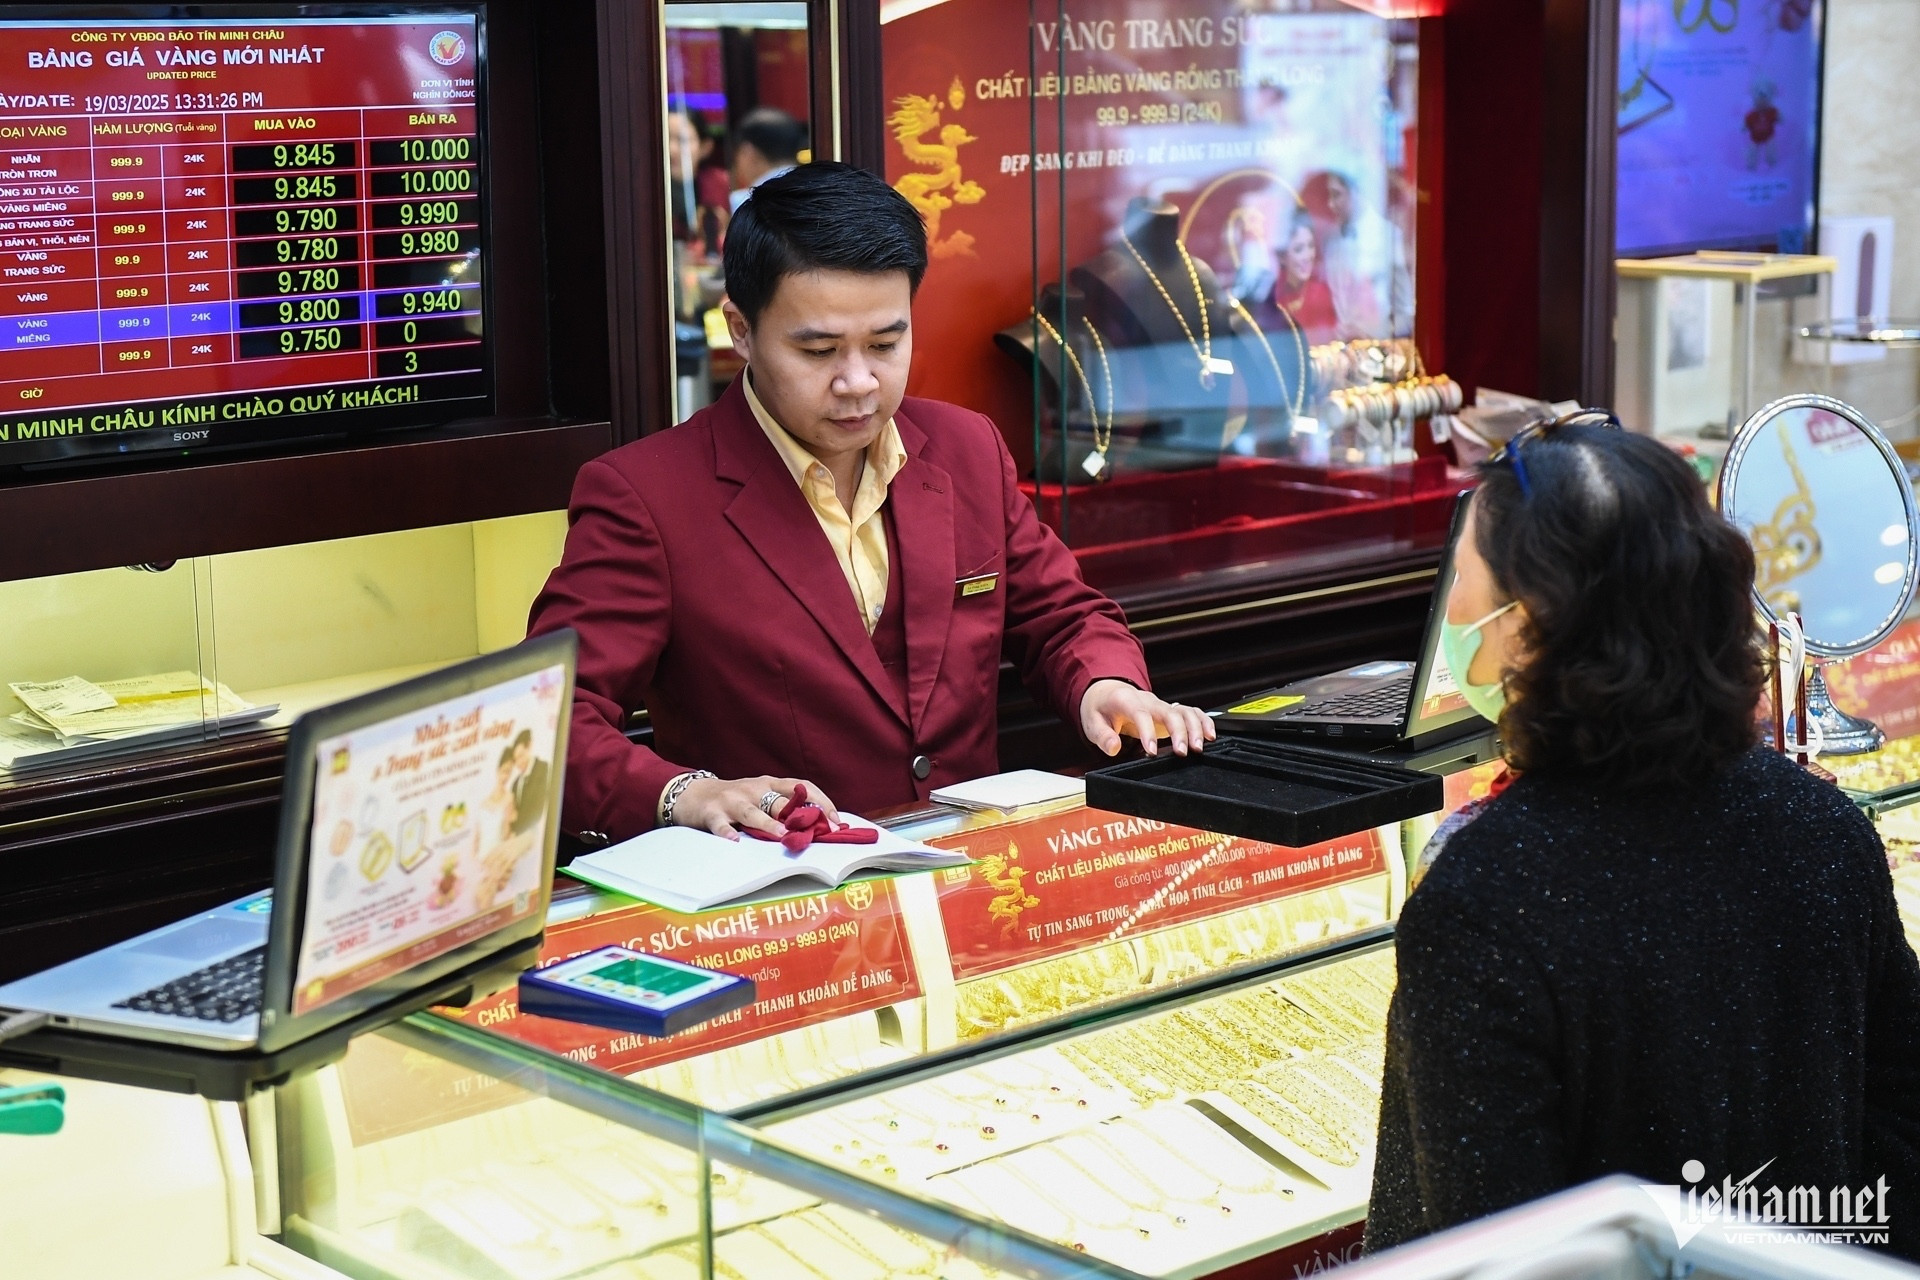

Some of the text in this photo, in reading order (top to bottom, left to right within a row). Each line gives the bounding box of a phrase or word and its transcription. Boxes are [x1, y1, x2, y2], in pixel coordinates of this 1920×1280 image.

[71, 31, 108, 42] CÔNG
[111, 32, 127, 42] TY
[130, 32, 165, 42] VBĐQ
[197, 30, 216, 41] TÍN
[220, 31, 249, 41] MINH
[252, 29, 285, 40] CHÂU
[1123, 17, 1214, 49] TRANG
[28, 44, 325, 68] BẢNG GIÁ VÀNG MỚI NHẤT
[147, 70, 217, 80] UPDATED PRICE
[454, 78, 474, 87] TÍNH
[976, 69, 1024, 100] CHẤT
[1073, 65, 1122, 95] BẰNG
[1125, 67, 1172, 93] VÀNG
[85, 94, 169, 114] 19/03/2025
[175, 92, 238, 109] 13:31:26
[242, 92, 263, 107] PM
[409, 113, 457, 125] BÁN RA
[1096, 105, 1129, 127] 99.9
[1139, 103, 1181, 125] 999.9
[93, 122, 122, 134] HÀM
[125, 122, 173, 135] LƯỢNG
[254, 117, 316, 130] MUA VÀO
[0, 124, 67, 139] OẠI VÀNG
[273, 143, 335, 167] 9.845
[400, 138, 469, 162] 10.000
[110, 157, 143, 167] 999.9
[184, 155, 205, 163] 24K
[1000, 153, 1030, 177] ĐẸP
[1077, 150, 1104, 169] KHI
[27, 169, 57, 178] TRƠN
[400, 169, 471, 193] 10.000
[23, 188, 37, 196] XU
[39, 185, 56, 195] TÀI
[58, 184, 80, 195] LỘC
[185, 188, 206, 196] 24K
[275, 176, 336, 199] 9.845
[112, 191, 145, 200] 999.9
[276, 208, 337, 232] 9.790
[400, 202, 459, 226] 9.990
[17, 218, 75, 229] TRANG SỨC
[113, 224, 146, 234] 999.9
[186, 220, 207, 229] 24K
[277, 237, 338, 262] 9.780
[401, 230, 459, 255] 9.980
[17, 251, 47, 261] VÀNG
[114, 255, 141, 265] 99.9
[187, 251, 208, 259] 24K
[4, 264, 66, 276] TRANG SỨC
[189, 283, 209, 292] 24K
[278, 268, 339, 293] 9.780
[17, 292, 48, 302] VÀNG
[116, 288, 148, 298] 999.9
[403, 290, 461, 314] 9.940
[191, 313, 211, 322] 24K
[279, 298, 340, 323] 9.800
[17, 319, 48, 329] VÀNG
[118, 317, 150, 328] 999.9
[403, 321, 417, 343] 0
[280, 327, 341, 353] 9.750
[119, 350, 151, 361] 999.9
[191, 345, 212, 354] 24K
[405, 351, 418, 373] 3
[20, 387, 43, 399] GIỜ
[17, 385, 419, 440] MINH CHÂU KÍNH CHÀO QUÝ KHÁCH!
[173, 430, 210, 442] SONY
[1047, 827, 1102, 854] VÀNG
[1035, 861, 1066, 885] CHẤT
[1067, 858, 1093, 878] LIỆU
[1094, 850, 1126, 871] BẰNG
[1126, 844, 1157, 863] VÀNG
[1114, 873, 1130, 889] Giá
[1027, 924, 1041, 942] TỰ
[1045, 921, 1063, 938] TIN
[1066, 913, 1093, 932] SANG
[1095, 905, 1130, 925] TRỌNG
[1192, 881, 1216, 900] TÍNH
[1218, 876, 1243, 894] CÁCH
[1252, 867, 1285, 886] THANH
[1287, 855, 1321, 877] KHOẢN
[1338, 847, 1363, 865] DÀNG
[650, 923, 693, 954] SỨC
[695, 904, 760, 942] NGHỆ
[725, 921, 859, 966] LONG 99.9 999.9 (24K)
[754, 994, 795, 1017] THANH
[797, 980, 840, 1006] KHOẢN
[843, 974, 858, 994] DỄ
[861, 968, 893, 989] DÀNG
[477, 999, 517, 1027] CHẤT
